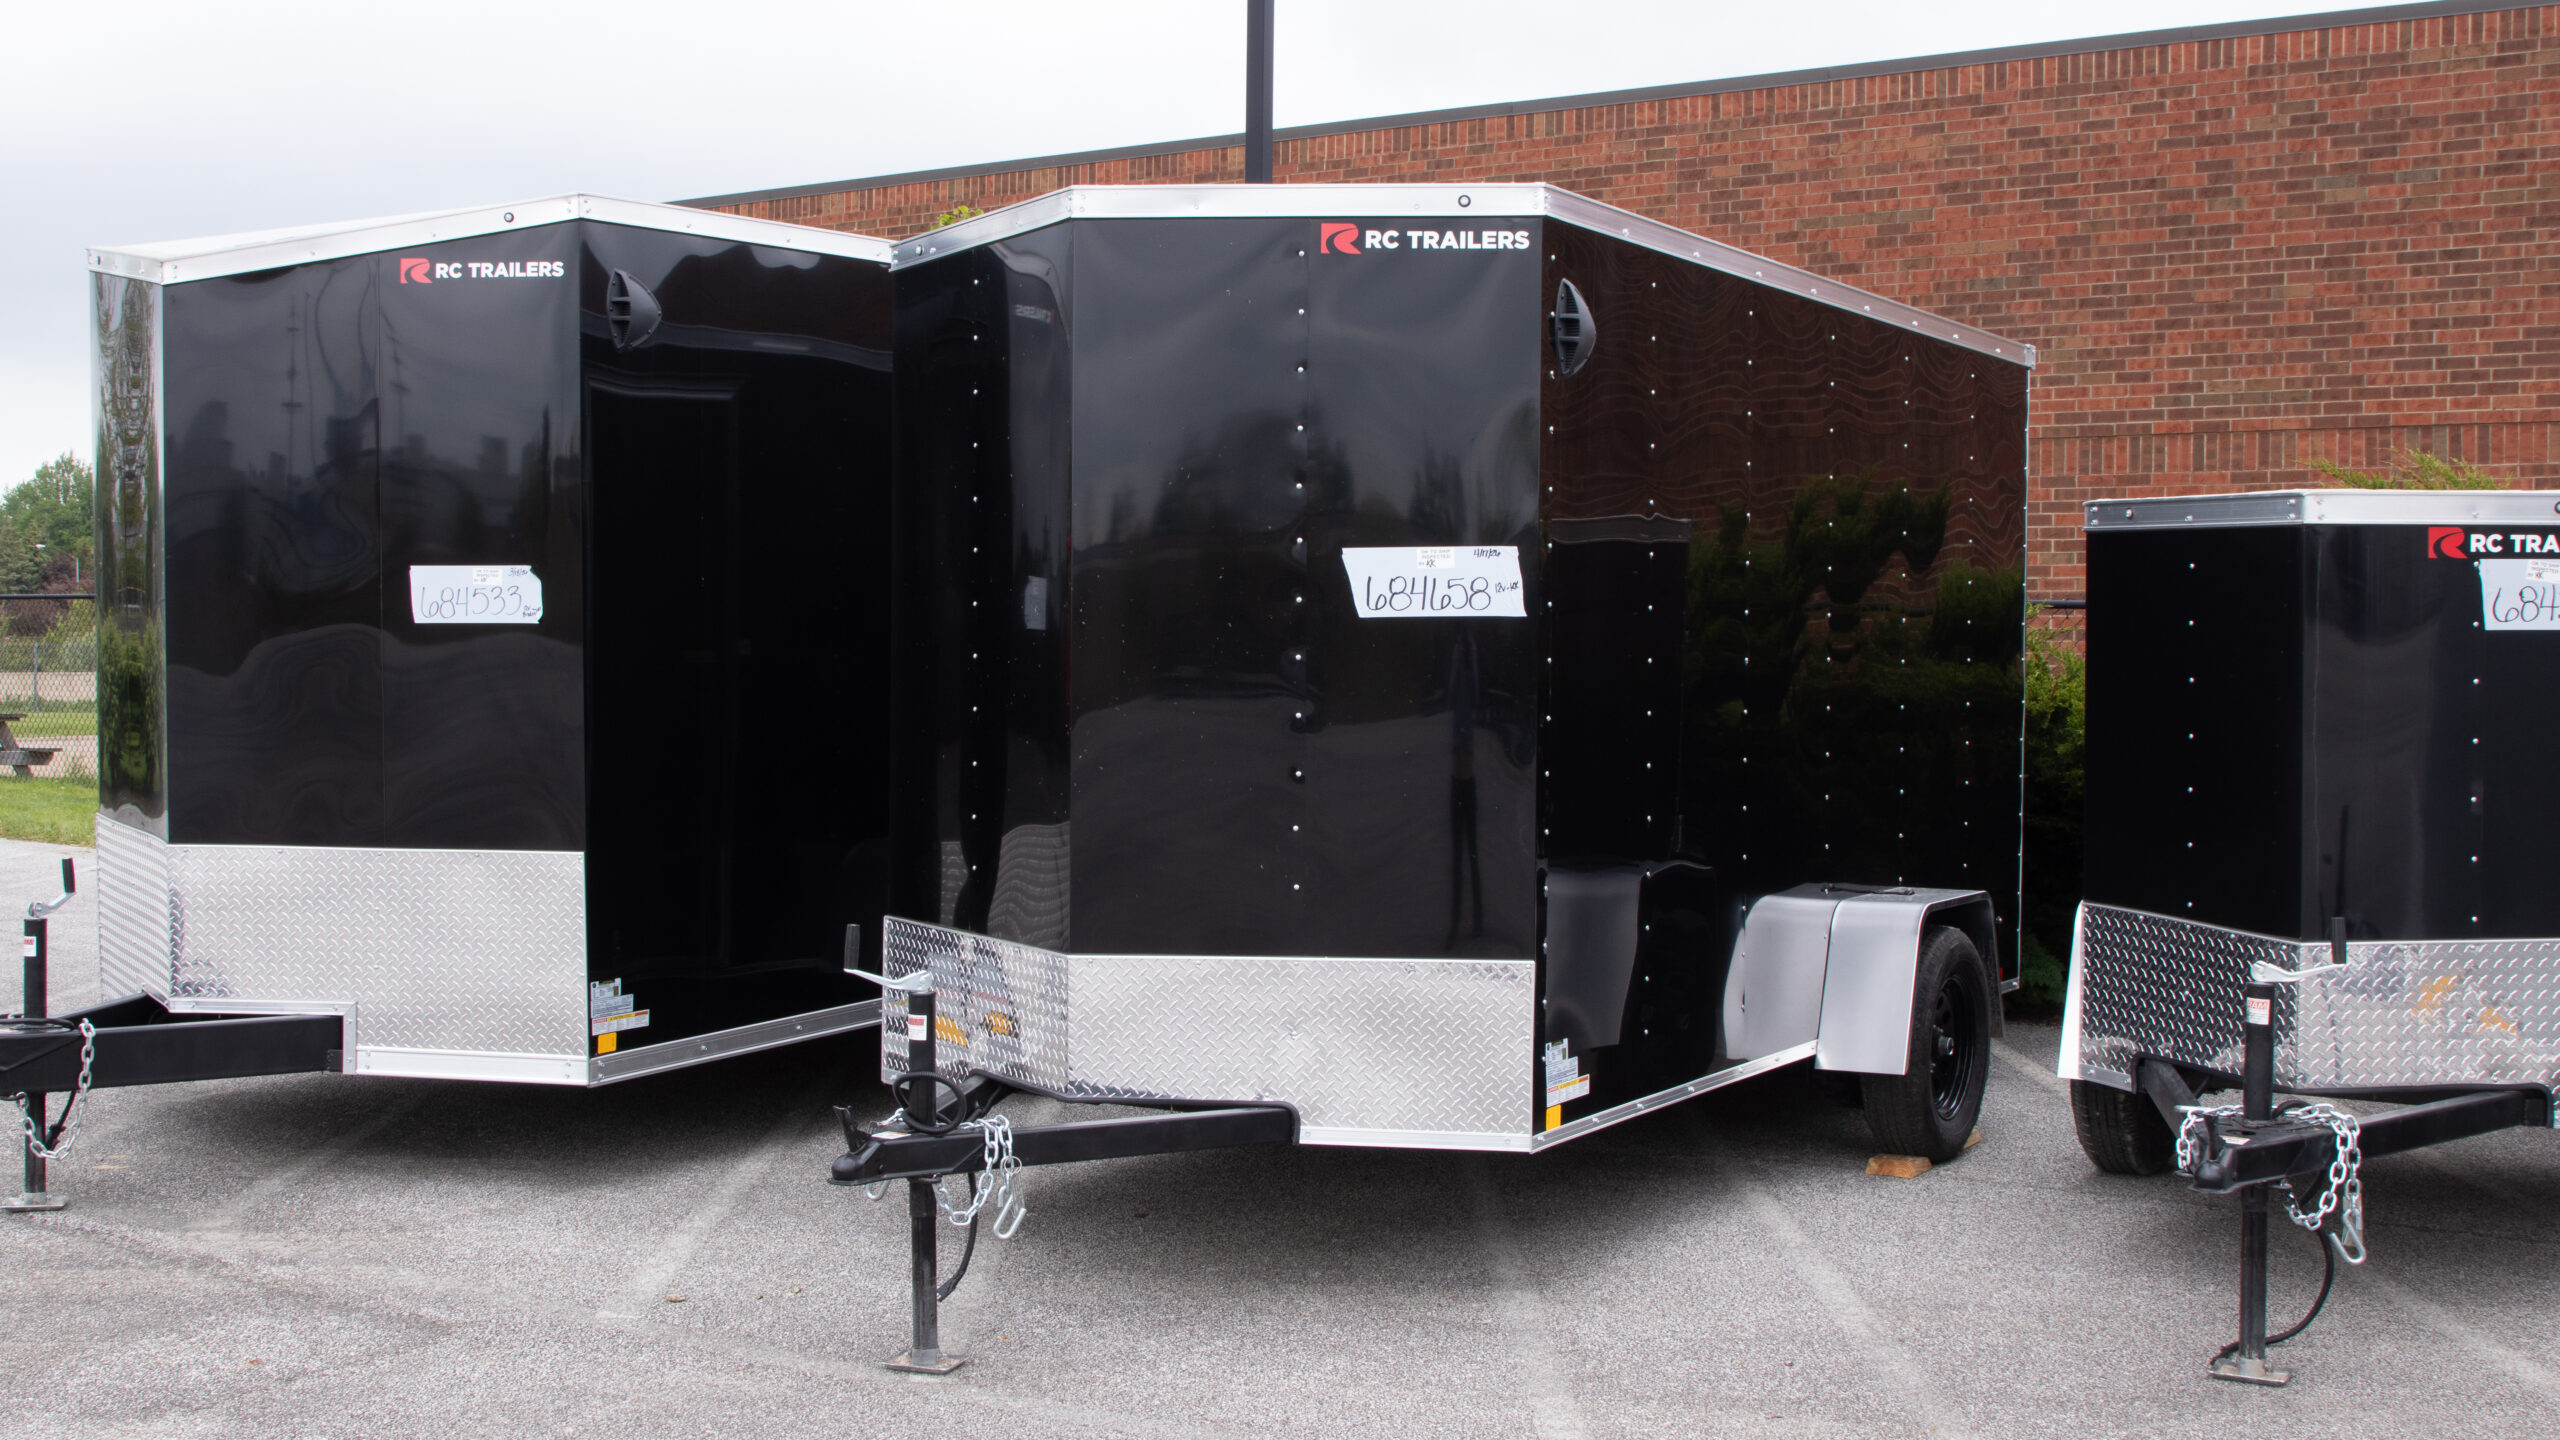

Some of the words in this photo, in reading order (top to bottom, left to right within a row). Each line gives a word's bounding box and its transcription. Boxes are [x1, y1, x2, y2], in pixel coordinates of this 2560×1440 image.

[1365, 230, 1399, 249] RC
[1407, 230, 1530, 249] TRAILERS
[435, 262, 463, 279] RC
[468, 261, 565, 278] TRAILERS
[2470, 533, 2504, 553] RC
[2510, 533, 2560, 553] TRA
[421, 585, 522, 619] 684533
[1366, 575, 1491, 611] 684658
[2492, 584, 2560, 623] 684
